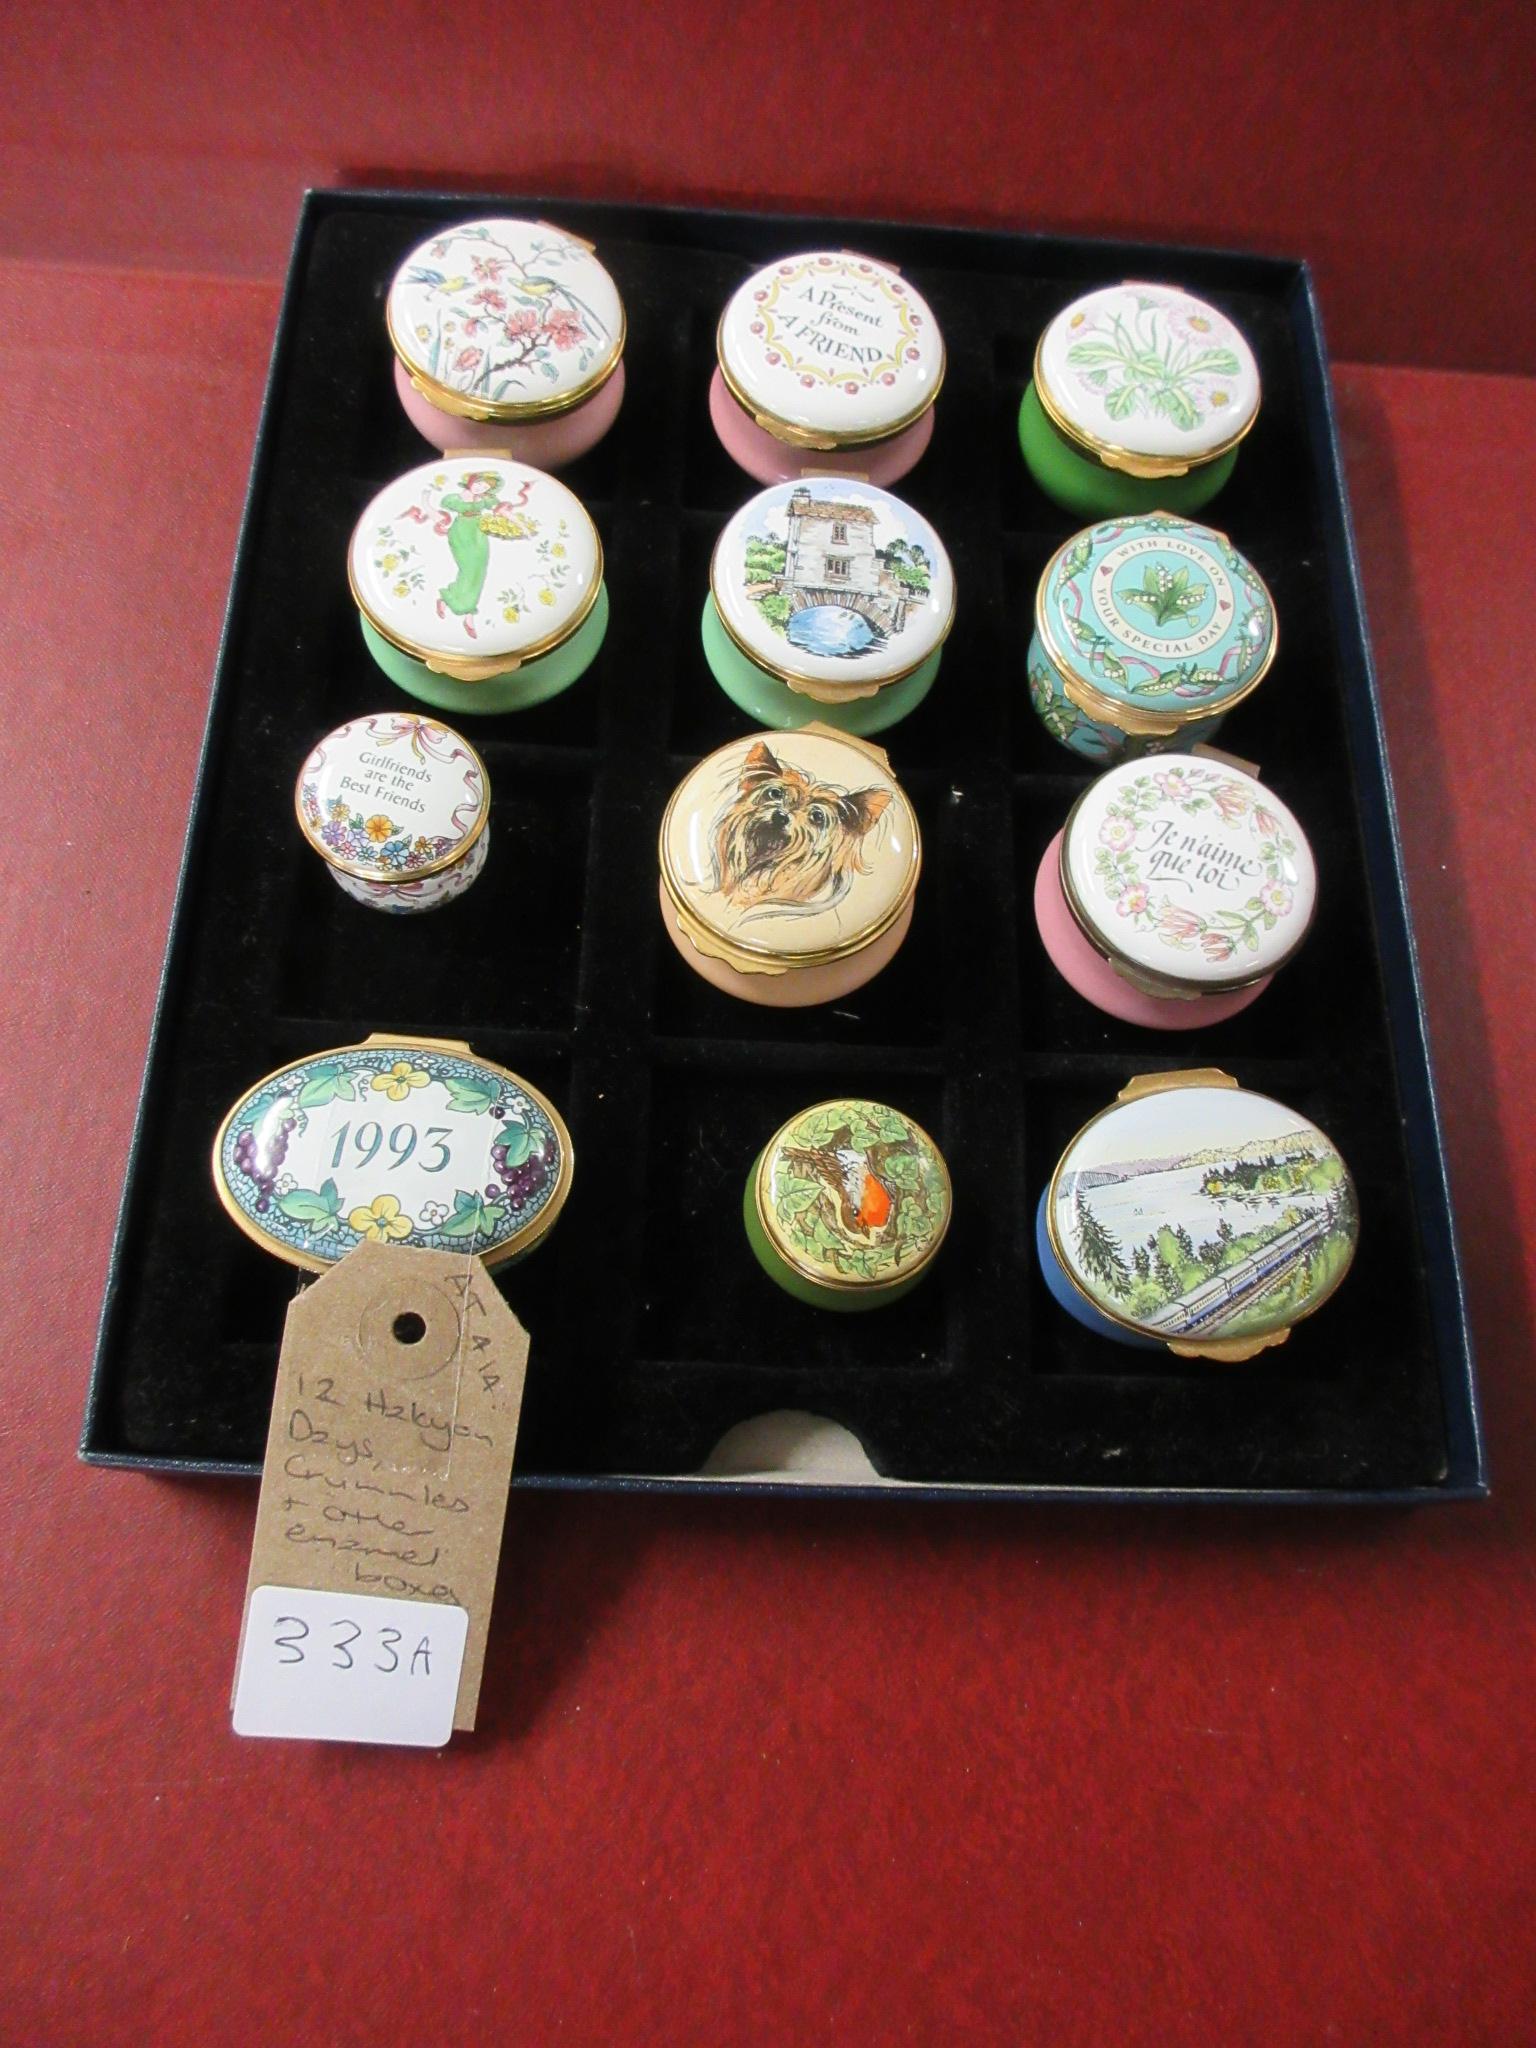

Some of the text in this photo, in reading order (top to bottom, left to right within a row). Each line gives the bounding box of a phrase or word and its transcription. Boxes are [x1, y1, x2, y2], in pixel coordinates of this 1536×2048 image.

[798, 286, 885, 328] A Present
[810, 311, 861, 336] from
[778, 312, 883, 364] A FRIEND
[1117, 540, 1226, 587] WITH LOVE ON
[1097, 588, 1222, 653] YOUR SPECIAL DAY
[358, 751, 432, 783] Girlfriends
[364, 768, 415, 791] are the
[340, 776, 426, 813] Best Friends
[1135, 820, 1263, 877] Je n'aime
[1146, 850, 1240, 893] que toi
[330, 1120, 454, 1173] 1993
[298, 1376, 345, 1407] 12
[285, 1523, 438, 1566] enamel
[273, 1616, 433, 1675] 333A
